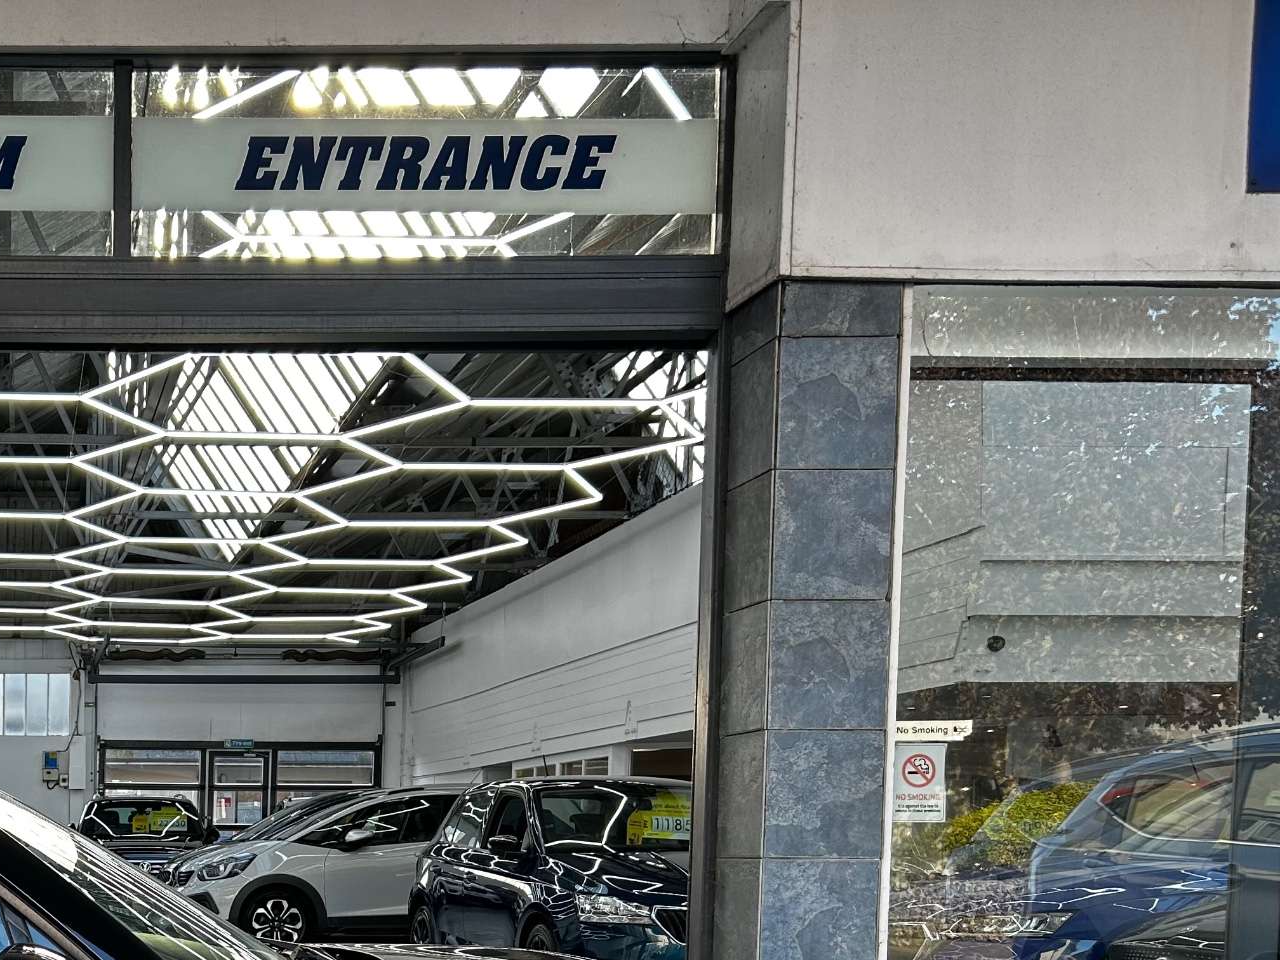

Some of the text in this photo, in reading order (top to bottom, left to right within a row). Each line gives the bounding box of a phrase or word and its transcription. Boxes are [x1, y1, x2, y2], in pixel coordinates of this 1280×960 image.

[234, 134, 618, 192] ENTRANCE
[911, 726, 949, 735] Smoking
[895, 793, 907, 801] NO
